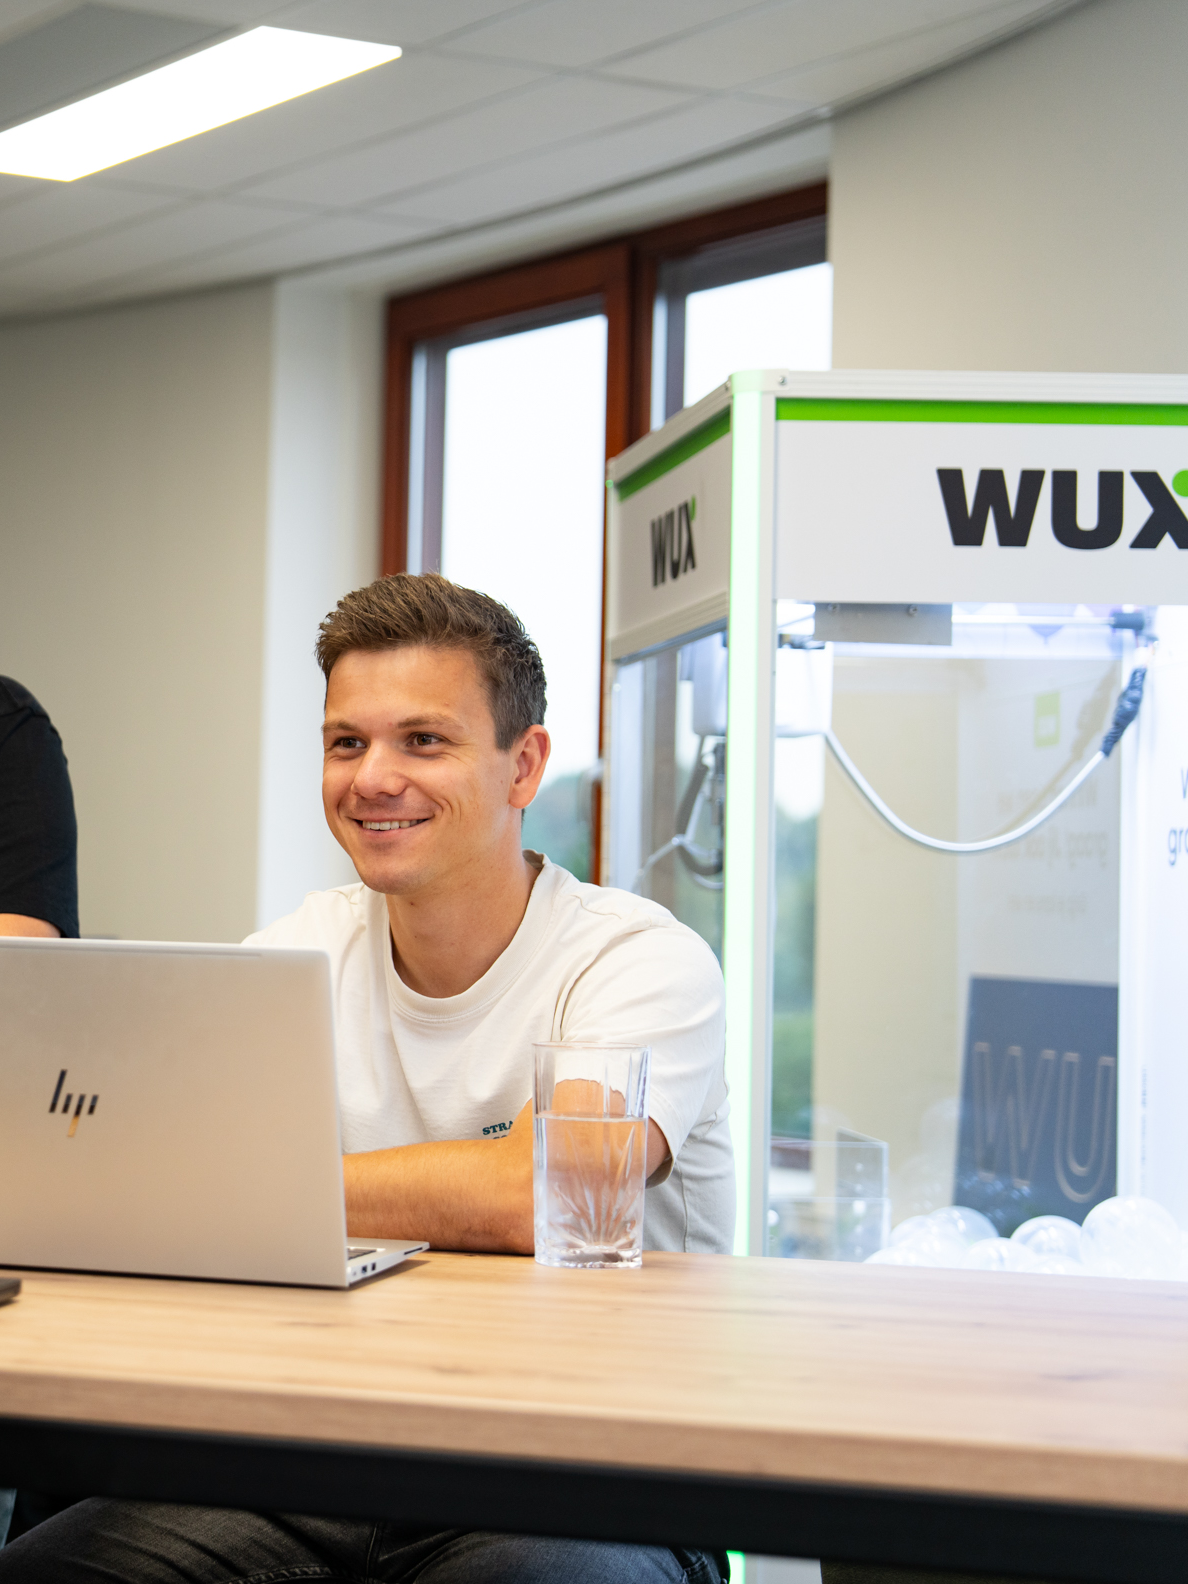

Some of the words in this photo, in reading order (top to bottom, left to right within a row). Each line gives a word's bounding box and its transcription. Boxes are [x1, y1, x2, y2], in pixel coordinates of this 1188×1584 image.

[650, 496, 696, 588] WUX
[936, 467, 1188, 550] WUX
[49, 1069, 99, 1138] hp
